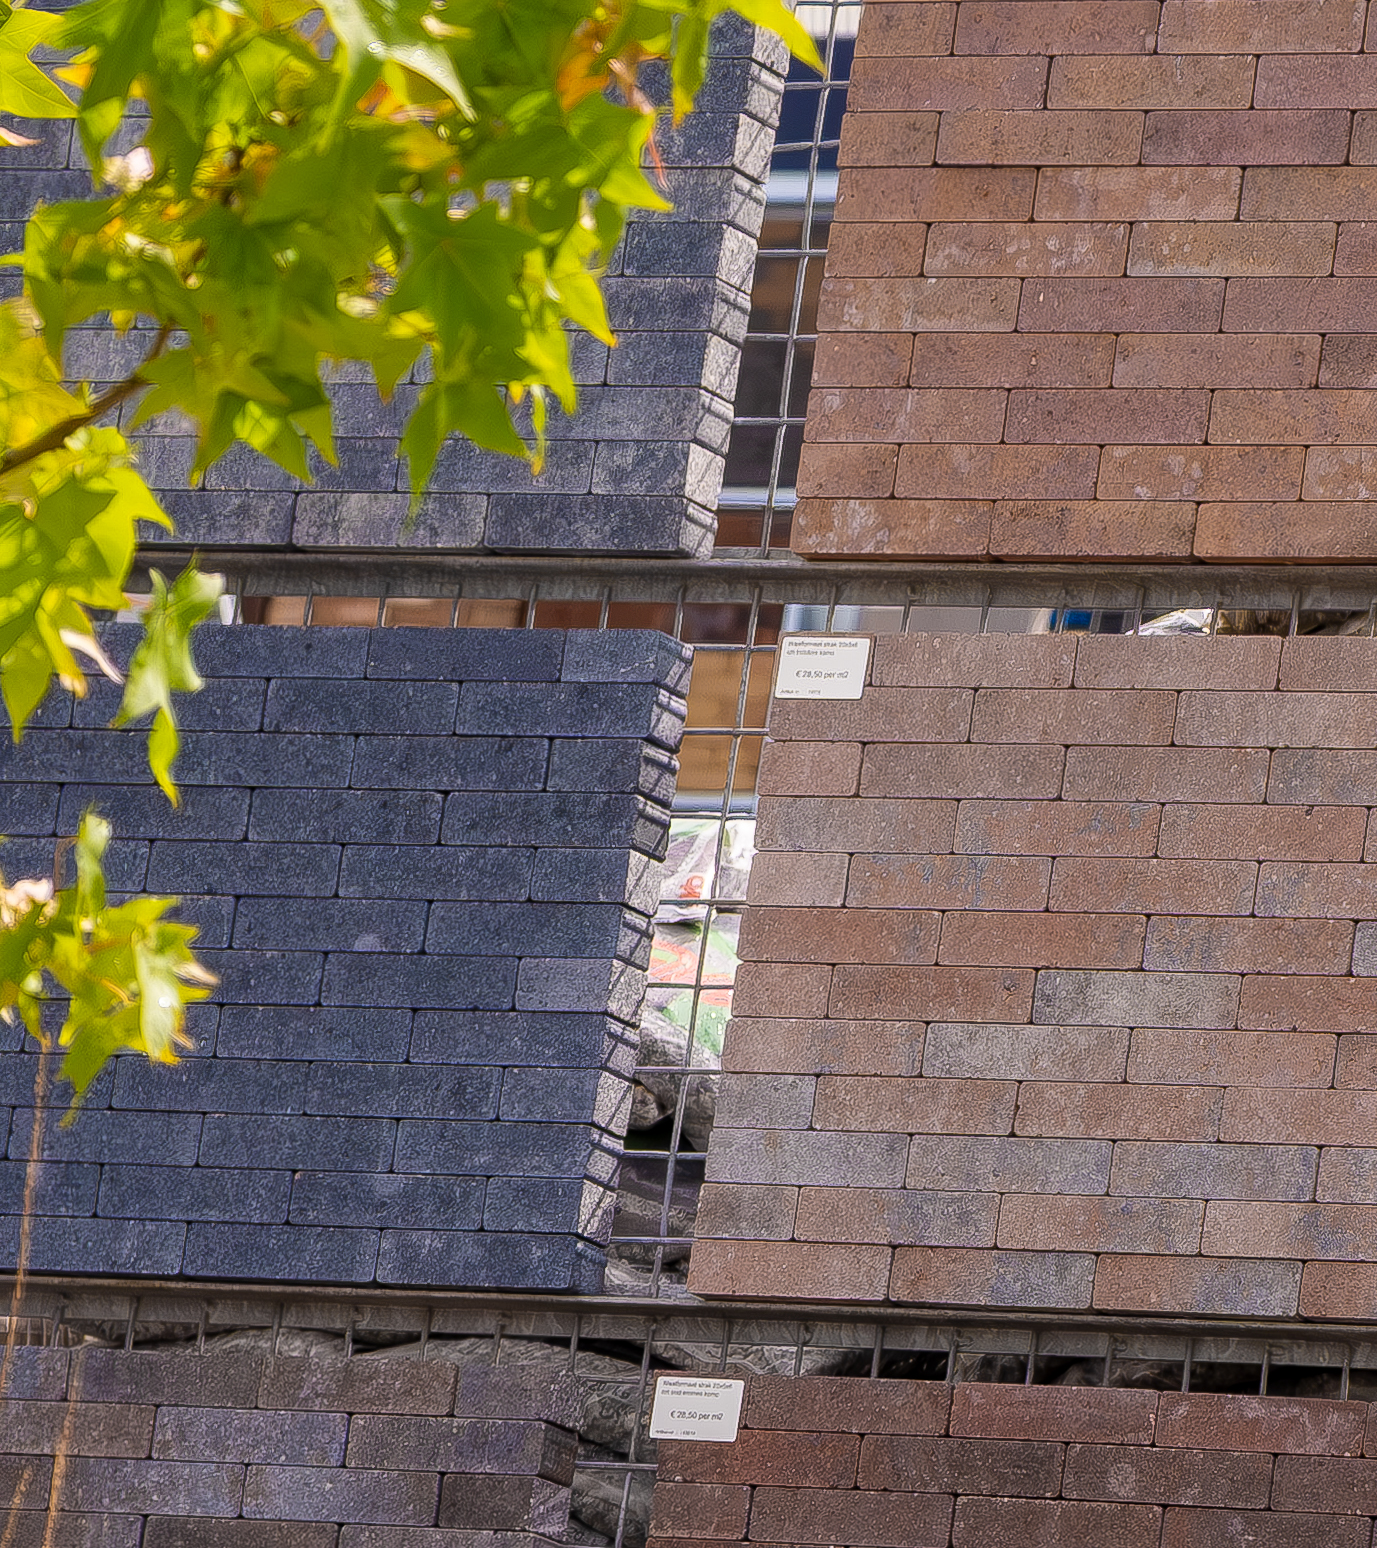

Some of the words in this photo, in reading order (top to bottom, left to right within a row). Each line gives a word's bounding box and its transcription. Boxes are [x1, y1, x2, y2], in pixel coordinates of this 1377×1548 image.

[802, 670, 823, 679] 28,50
[823, 671, 836, 679] per
[837, 670, 849, 678] m2
[698, 1413, 710, 1421] per
[711, 1413, 724, 1421] m2
